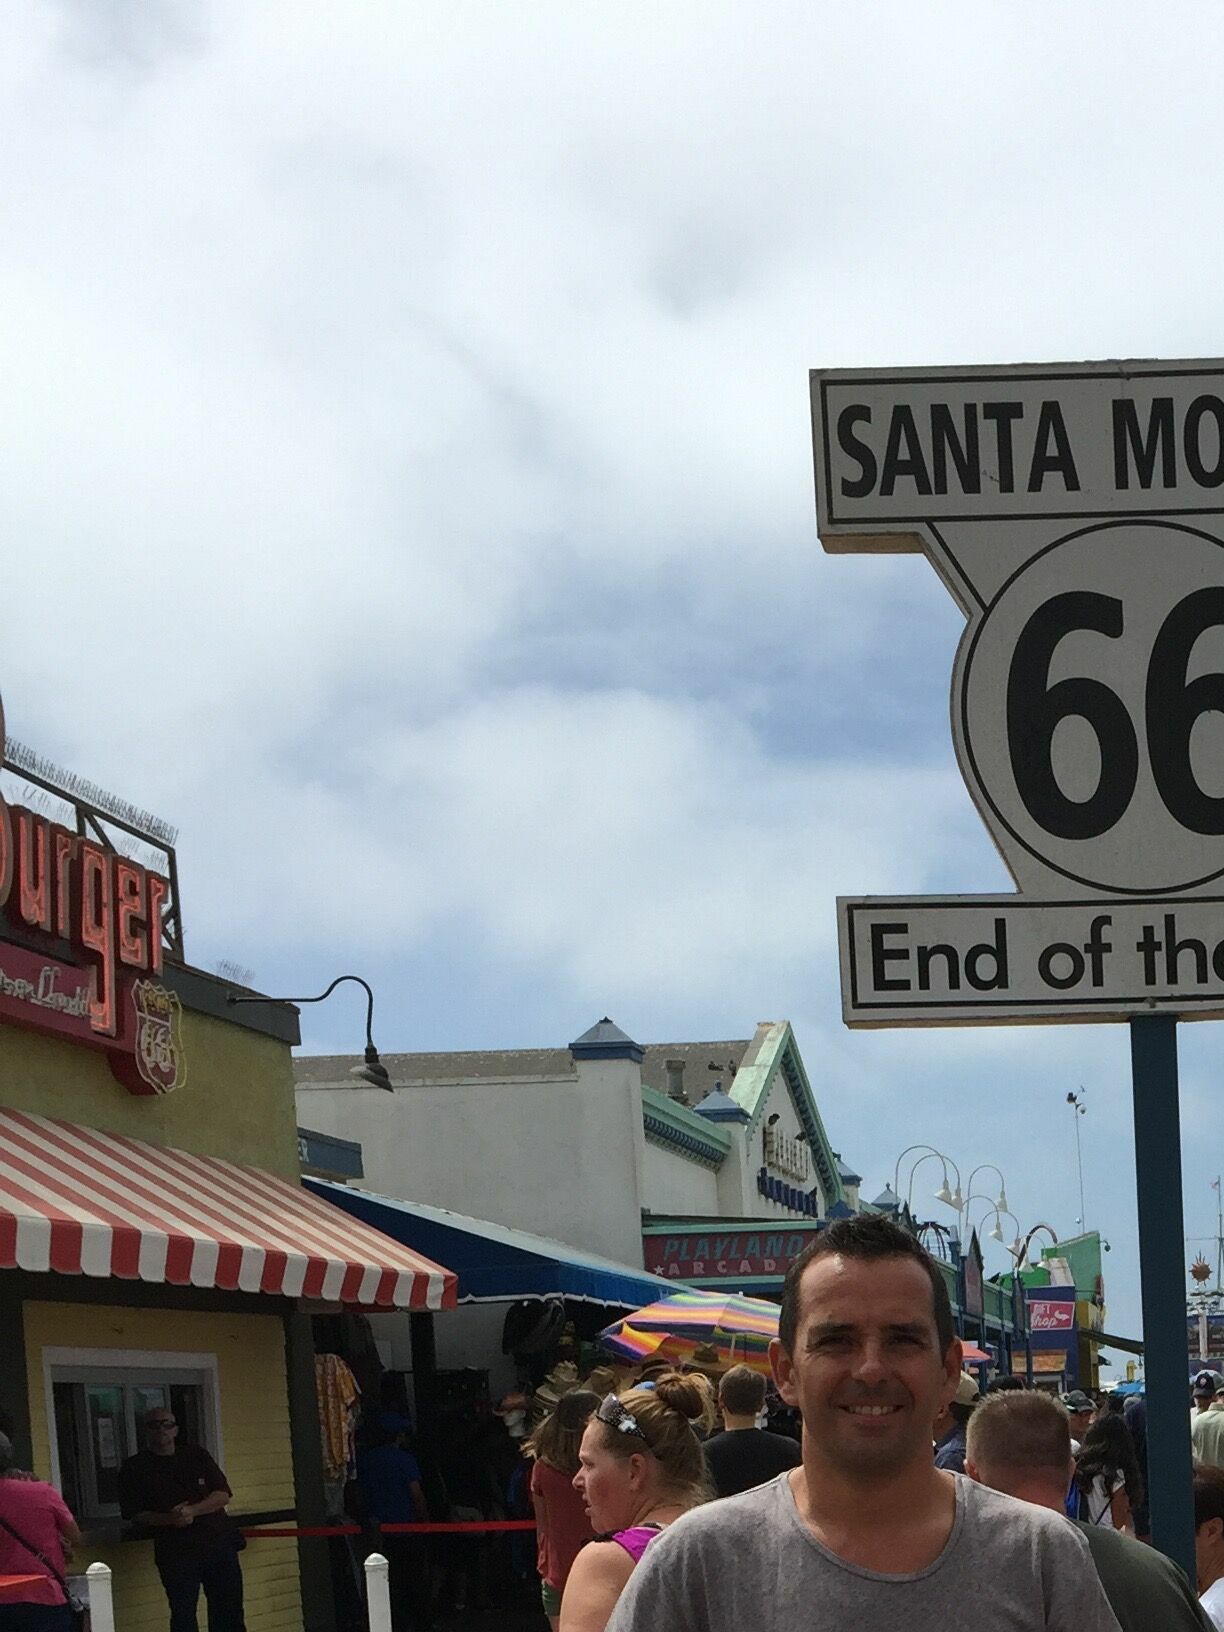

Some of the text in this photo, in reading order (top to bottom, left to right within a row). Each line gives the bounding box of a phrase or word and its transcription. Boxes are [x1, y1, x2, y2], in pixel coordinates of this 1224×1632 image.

[836, 399, 1081, 499] SANTA
[0, 790, 168, 1036] urger
[870, 918, 1010, 993] End
[1038, 915, 1112, 988] of
[663, 1234, 805, 1261] PLAYLAND
[668, 1258, 792, 1275] ARCAD
